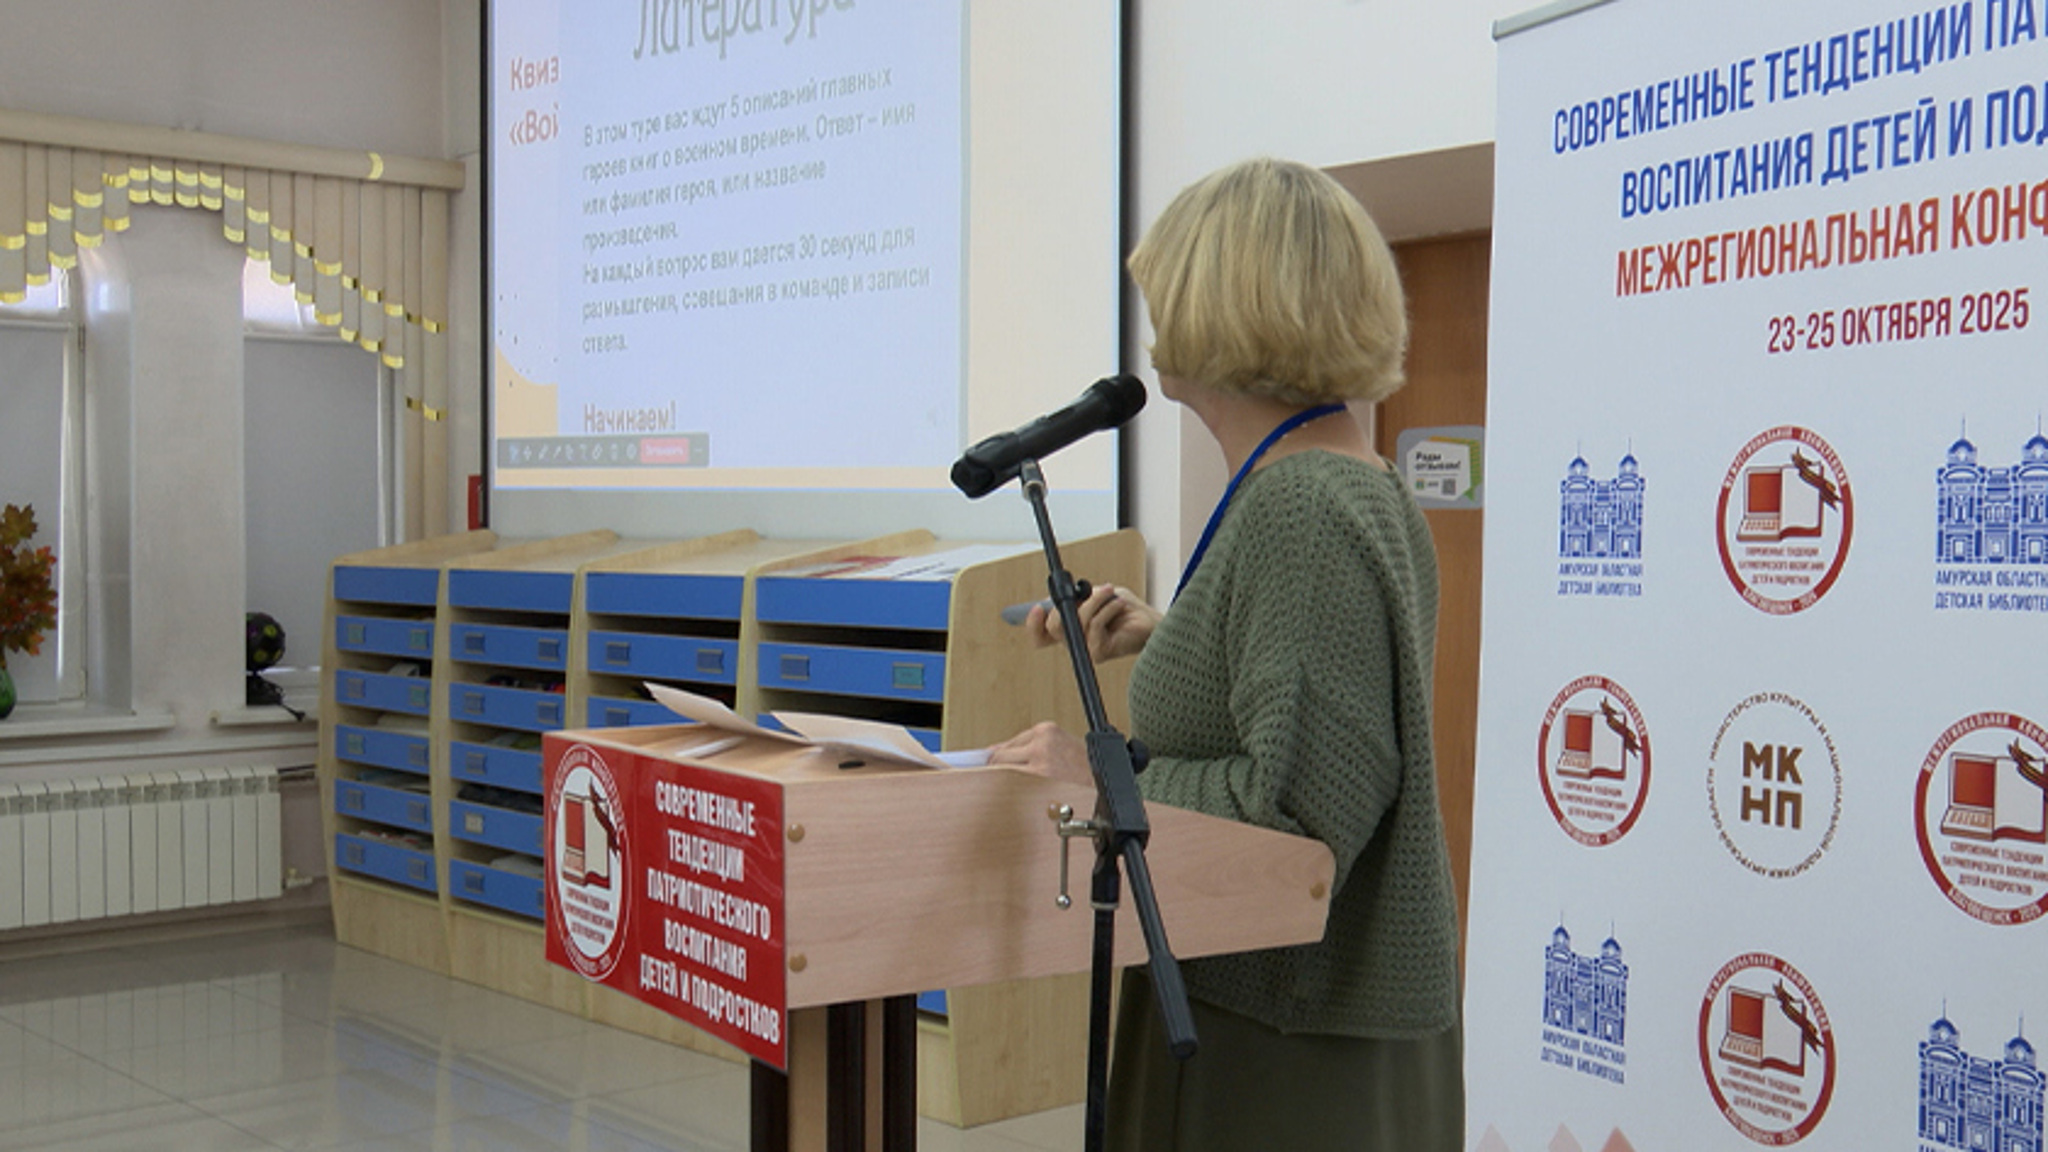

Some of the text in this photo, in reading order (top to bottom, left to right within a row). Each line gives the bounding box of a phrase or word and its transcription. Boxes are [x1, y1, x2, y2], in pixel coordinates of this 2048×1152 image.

[510, 56, 559, 91] Квиз
[1554, 0, 2048, 154] СОВРЕМЕННЫЕ ТЕНДЕНЦИИ ПА
[584, 124, 593, 147] В
[596, 123, 627, 145] этом
[631, 116, 661, 142] туре
[665, 111, 688, 131] вас
[692, 102, 727, 128] ждут
[731, 94, 739, 118] 5
[821, 67, 892, 100] главных
[663, 150, 671, 168] о
[674, 137, 737, 166] военном
[816, 113, 864, 140] Ответ
[882, 102, 915, 128] имя
[1621, 132, 1813, 219] ВОСПИТАНИЯ
[1821, 97, 1936, 186] ДЕТЕЙ
[1948, 98, 1973, 156] И
[711, 249, 738, 270] вам
[799, 233, 817, 260] 30
[821, 231, 876, 260] секунд
[882, 227, 915, 252] для
[1616, 197, 1940, 297] МЕЖРЕГИОНАЛЬНАЯ
[768, 283, 777, 301] в
[782, 275, 848, 300] команде
[853, 273, 863, 293] и
[868, 266, 930, 292] записи
[1768, 287, 2030, 354] 23-25 ОКТЯБРЯ 2025
[584, 400, 677, 433] Начинаем!
[655, 780, 756, 837] СОВРЕМЕННЫЕ
[668, 829, 744, 882] ТЕНДЕНЦИИ
[648, 867, 771, 941] ПАТРИОТИЧЕСКОГО
[664, 918, 747, 982] ВОСПИТАНИЯ
[640, 953, 678, 997] ДЕТЕЙ
[681, 974, 690, 1003] И
[692, 976, 780, 1045] ПОДРОСТКОВ
